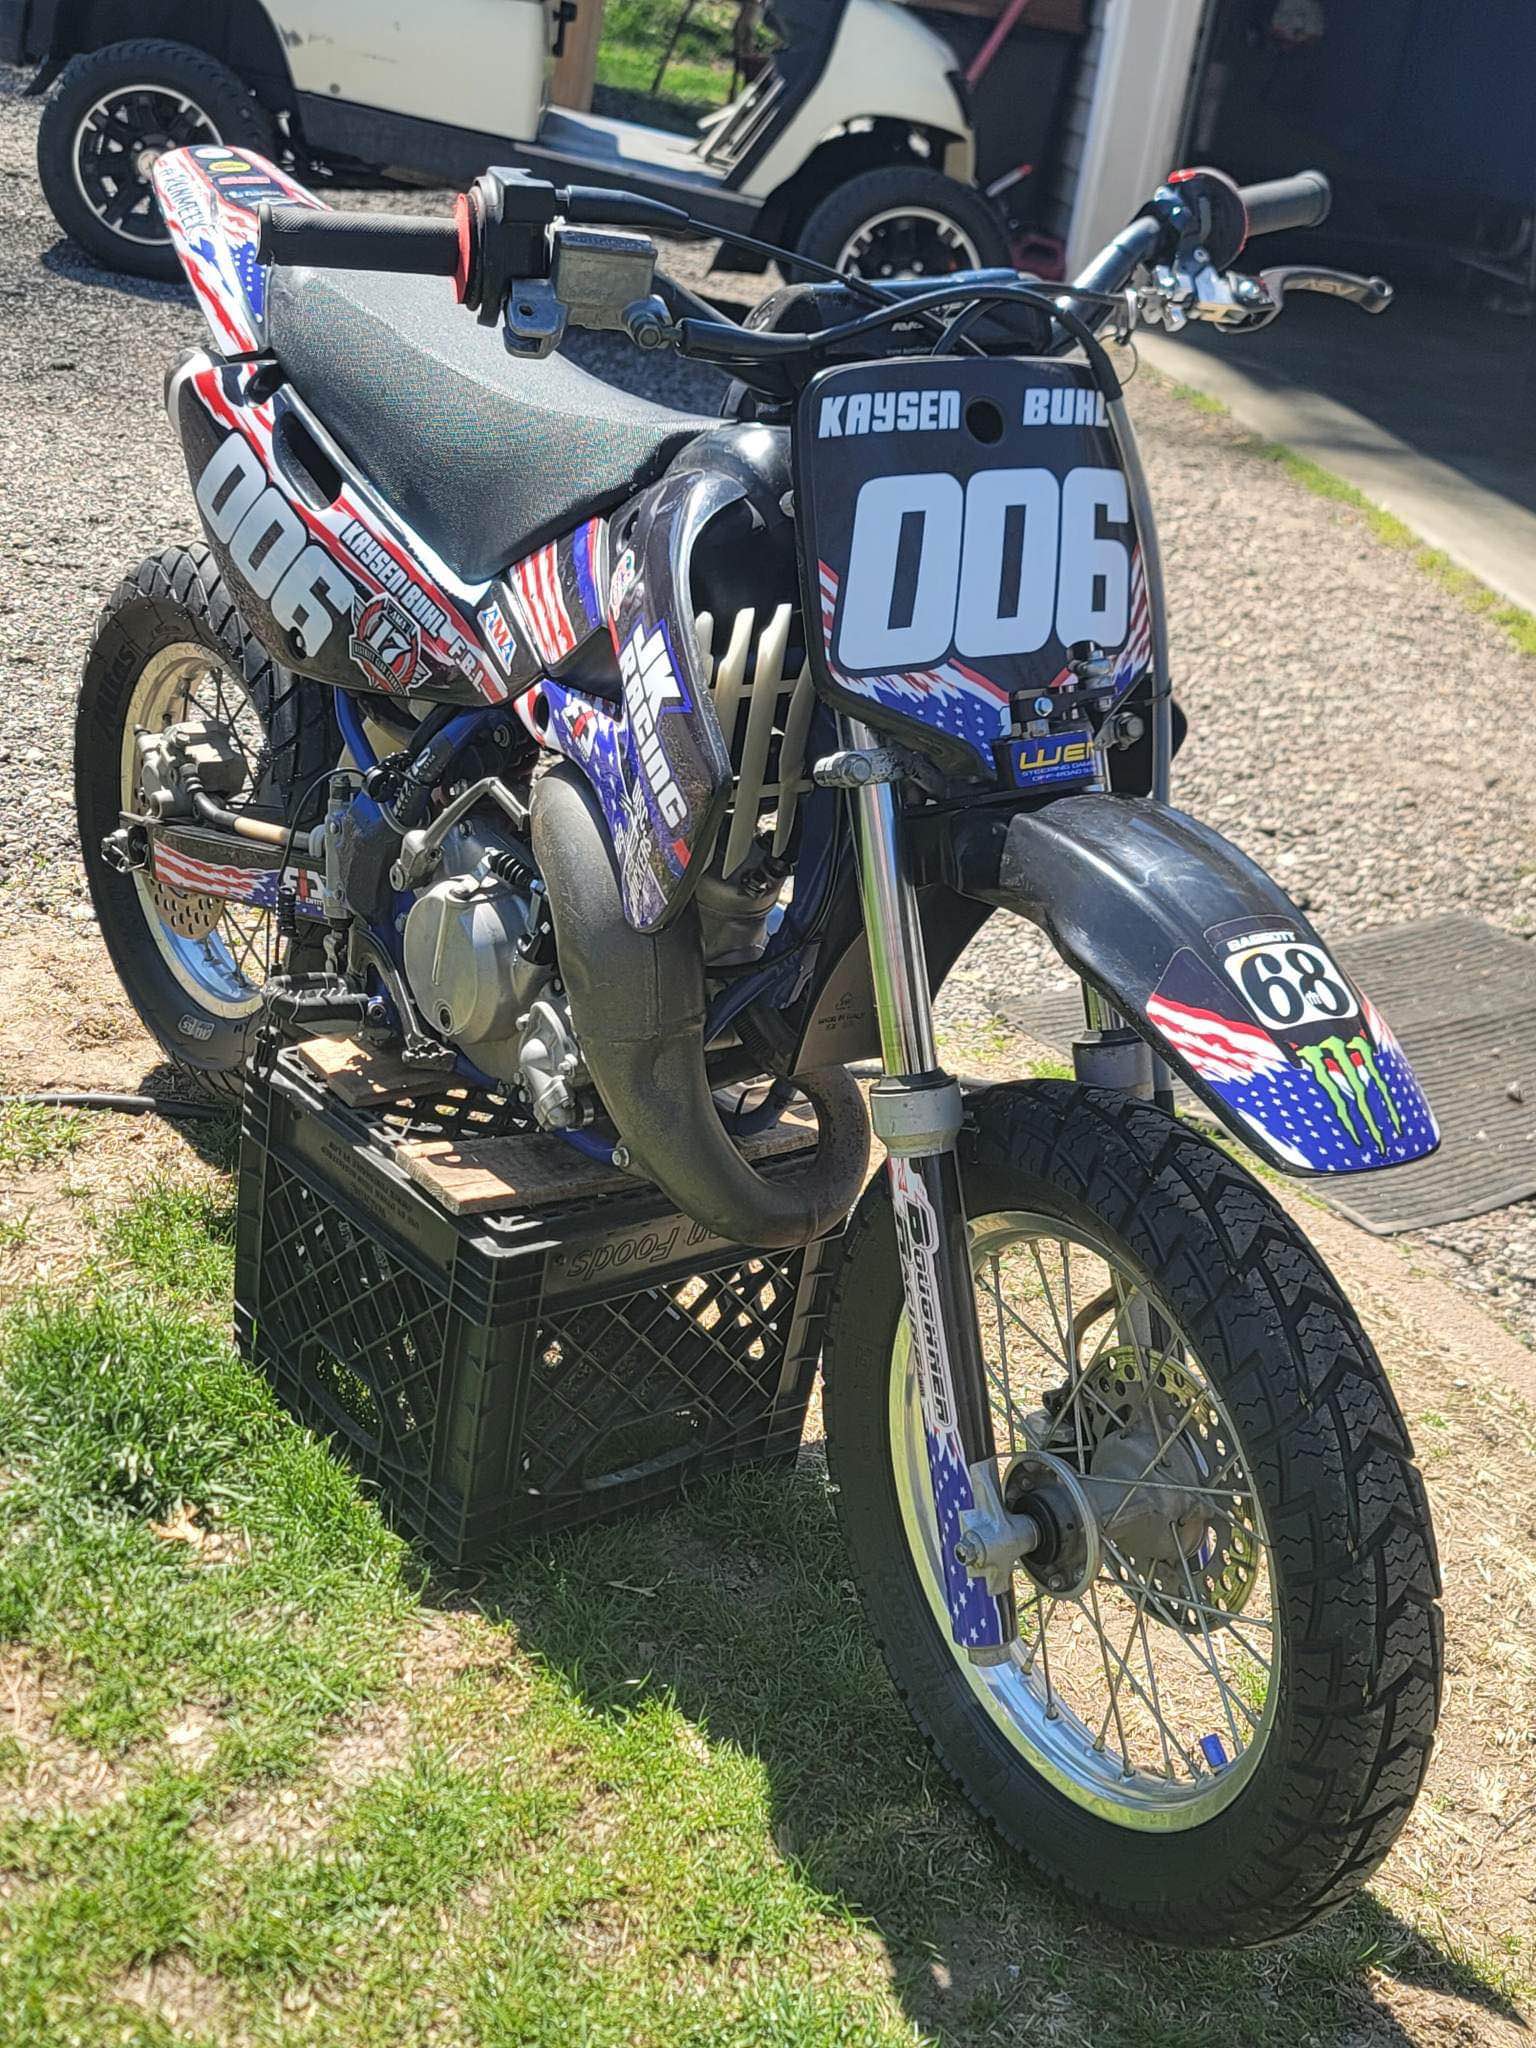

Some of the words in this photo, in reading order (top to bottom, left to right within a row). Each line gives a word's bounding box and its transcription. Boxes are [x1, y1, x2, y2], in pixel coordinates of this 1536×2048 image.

[818, 390, 961, 439] KAYSEN
[1023, 388, 1110, 429] BUHL
[196, 432, 356, 657] 006
[341, 520, 409, 595] KAYSEN
[404, 583, 447, 638] BUHL
[838, 467, 1129, 670] 006
[368, 615, 413, 665] 17
[481, 606, 515, 664] AMA
[633, 623, 682, 727] JK
[619, 639, 688, 829] RACING
[1240, 948, 1351, 1025] 68
[566, 1226, 681, 1281] Foods
[905, 1201, 950, 1425] BOUGHNER
